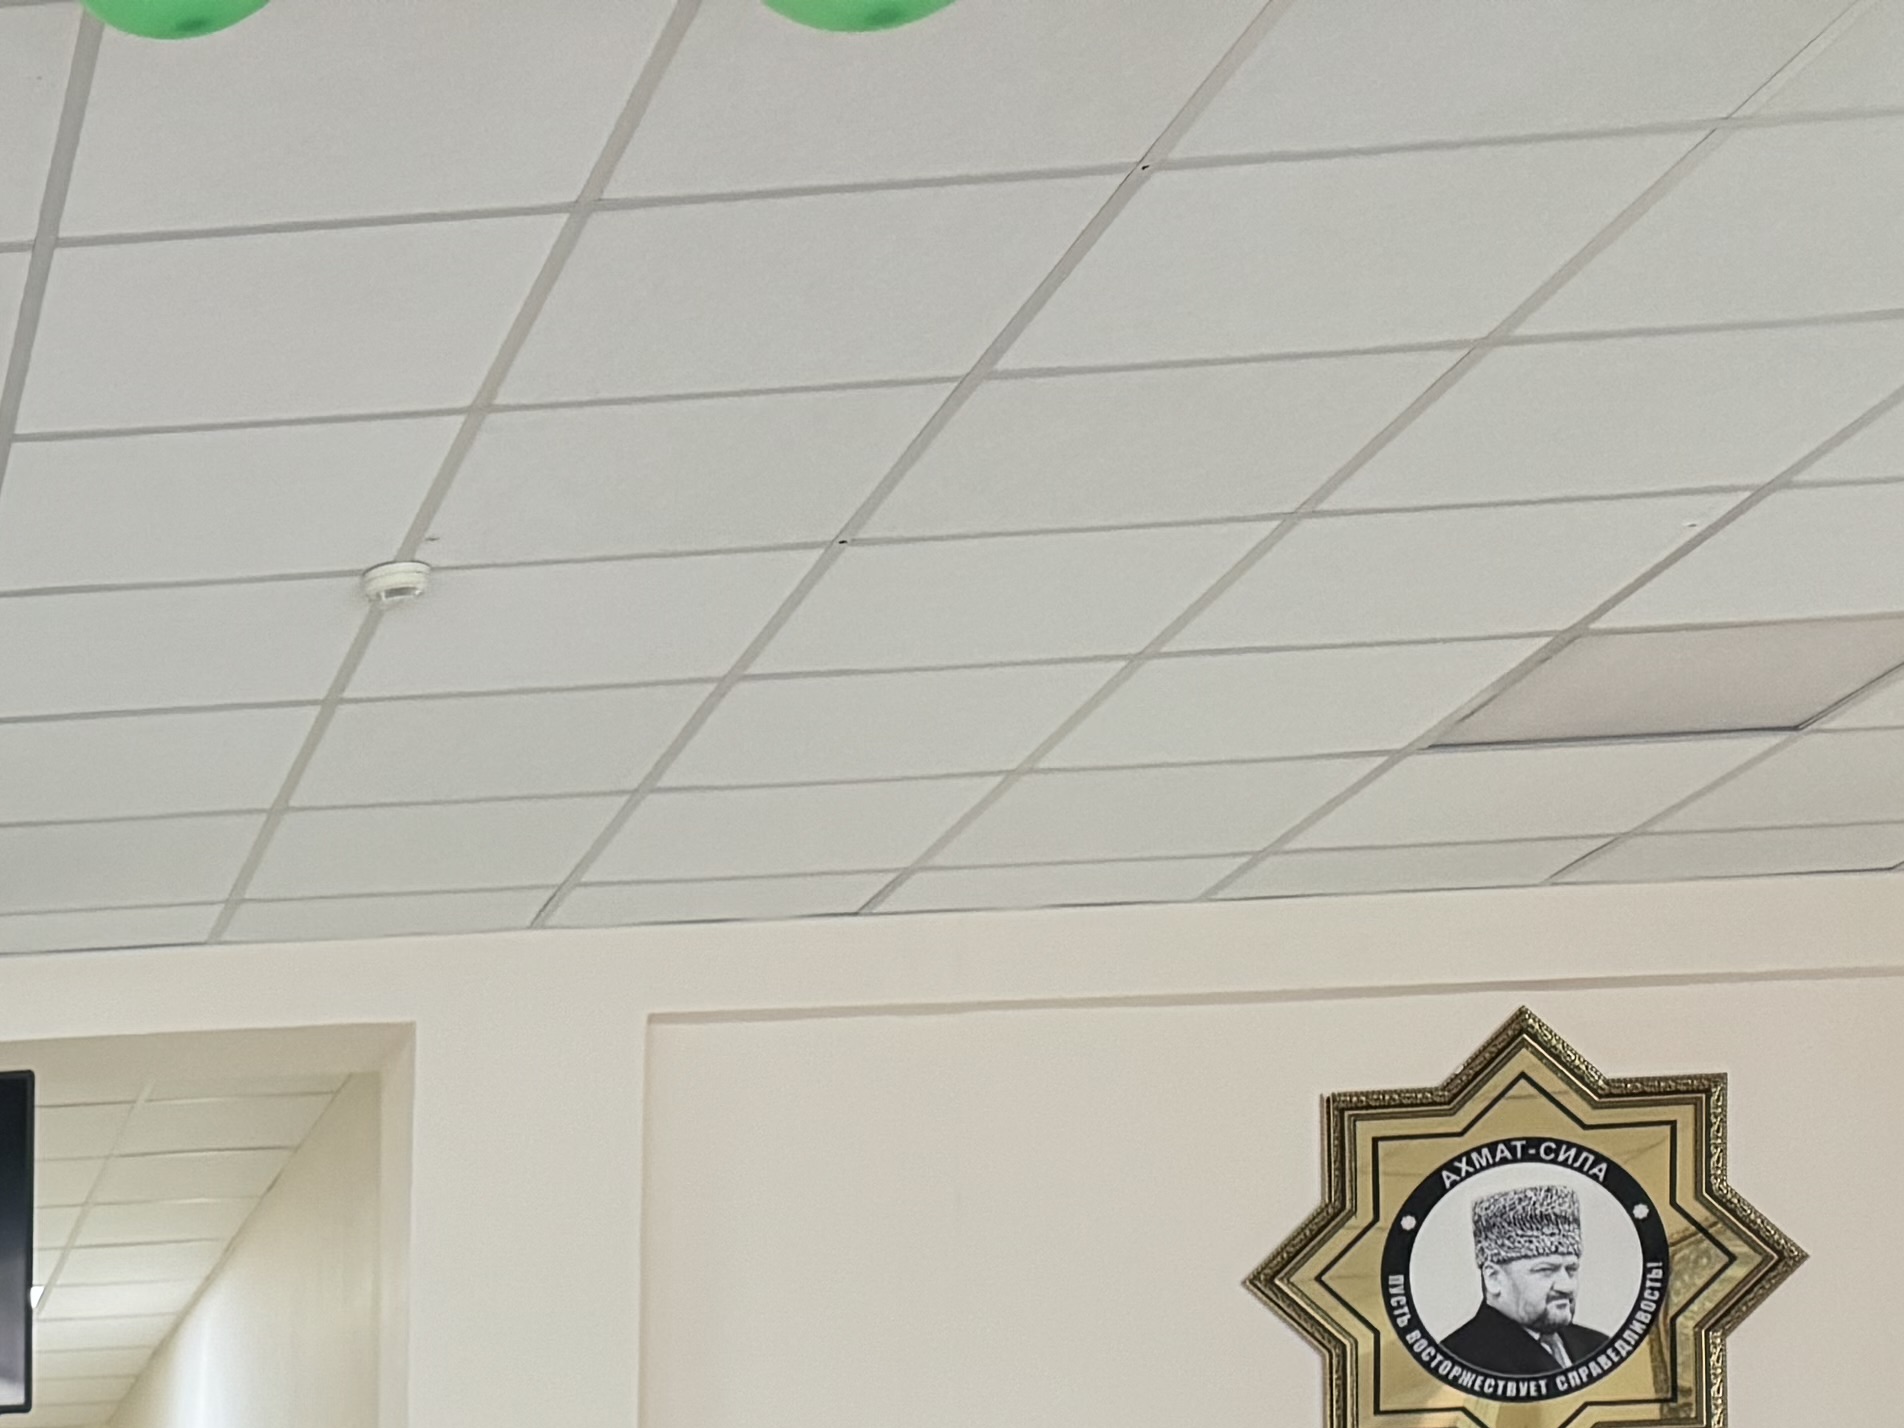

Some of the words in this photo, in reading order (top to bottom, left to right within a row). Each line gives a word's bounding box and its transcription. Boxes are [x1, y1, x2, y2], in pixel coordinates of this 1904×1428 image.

[1440, 1140, 1609, 1189] АХМАТ-СИЛА
[1388, 1274, 1412, 1328] ПУСТЬ
[1405, 1329, 1548, 1397] ВОСТОРЖЕСТВУЕТ
[1556, 1261, 1664, 1391] СПРАВЕДЛИВОСТЬ!
